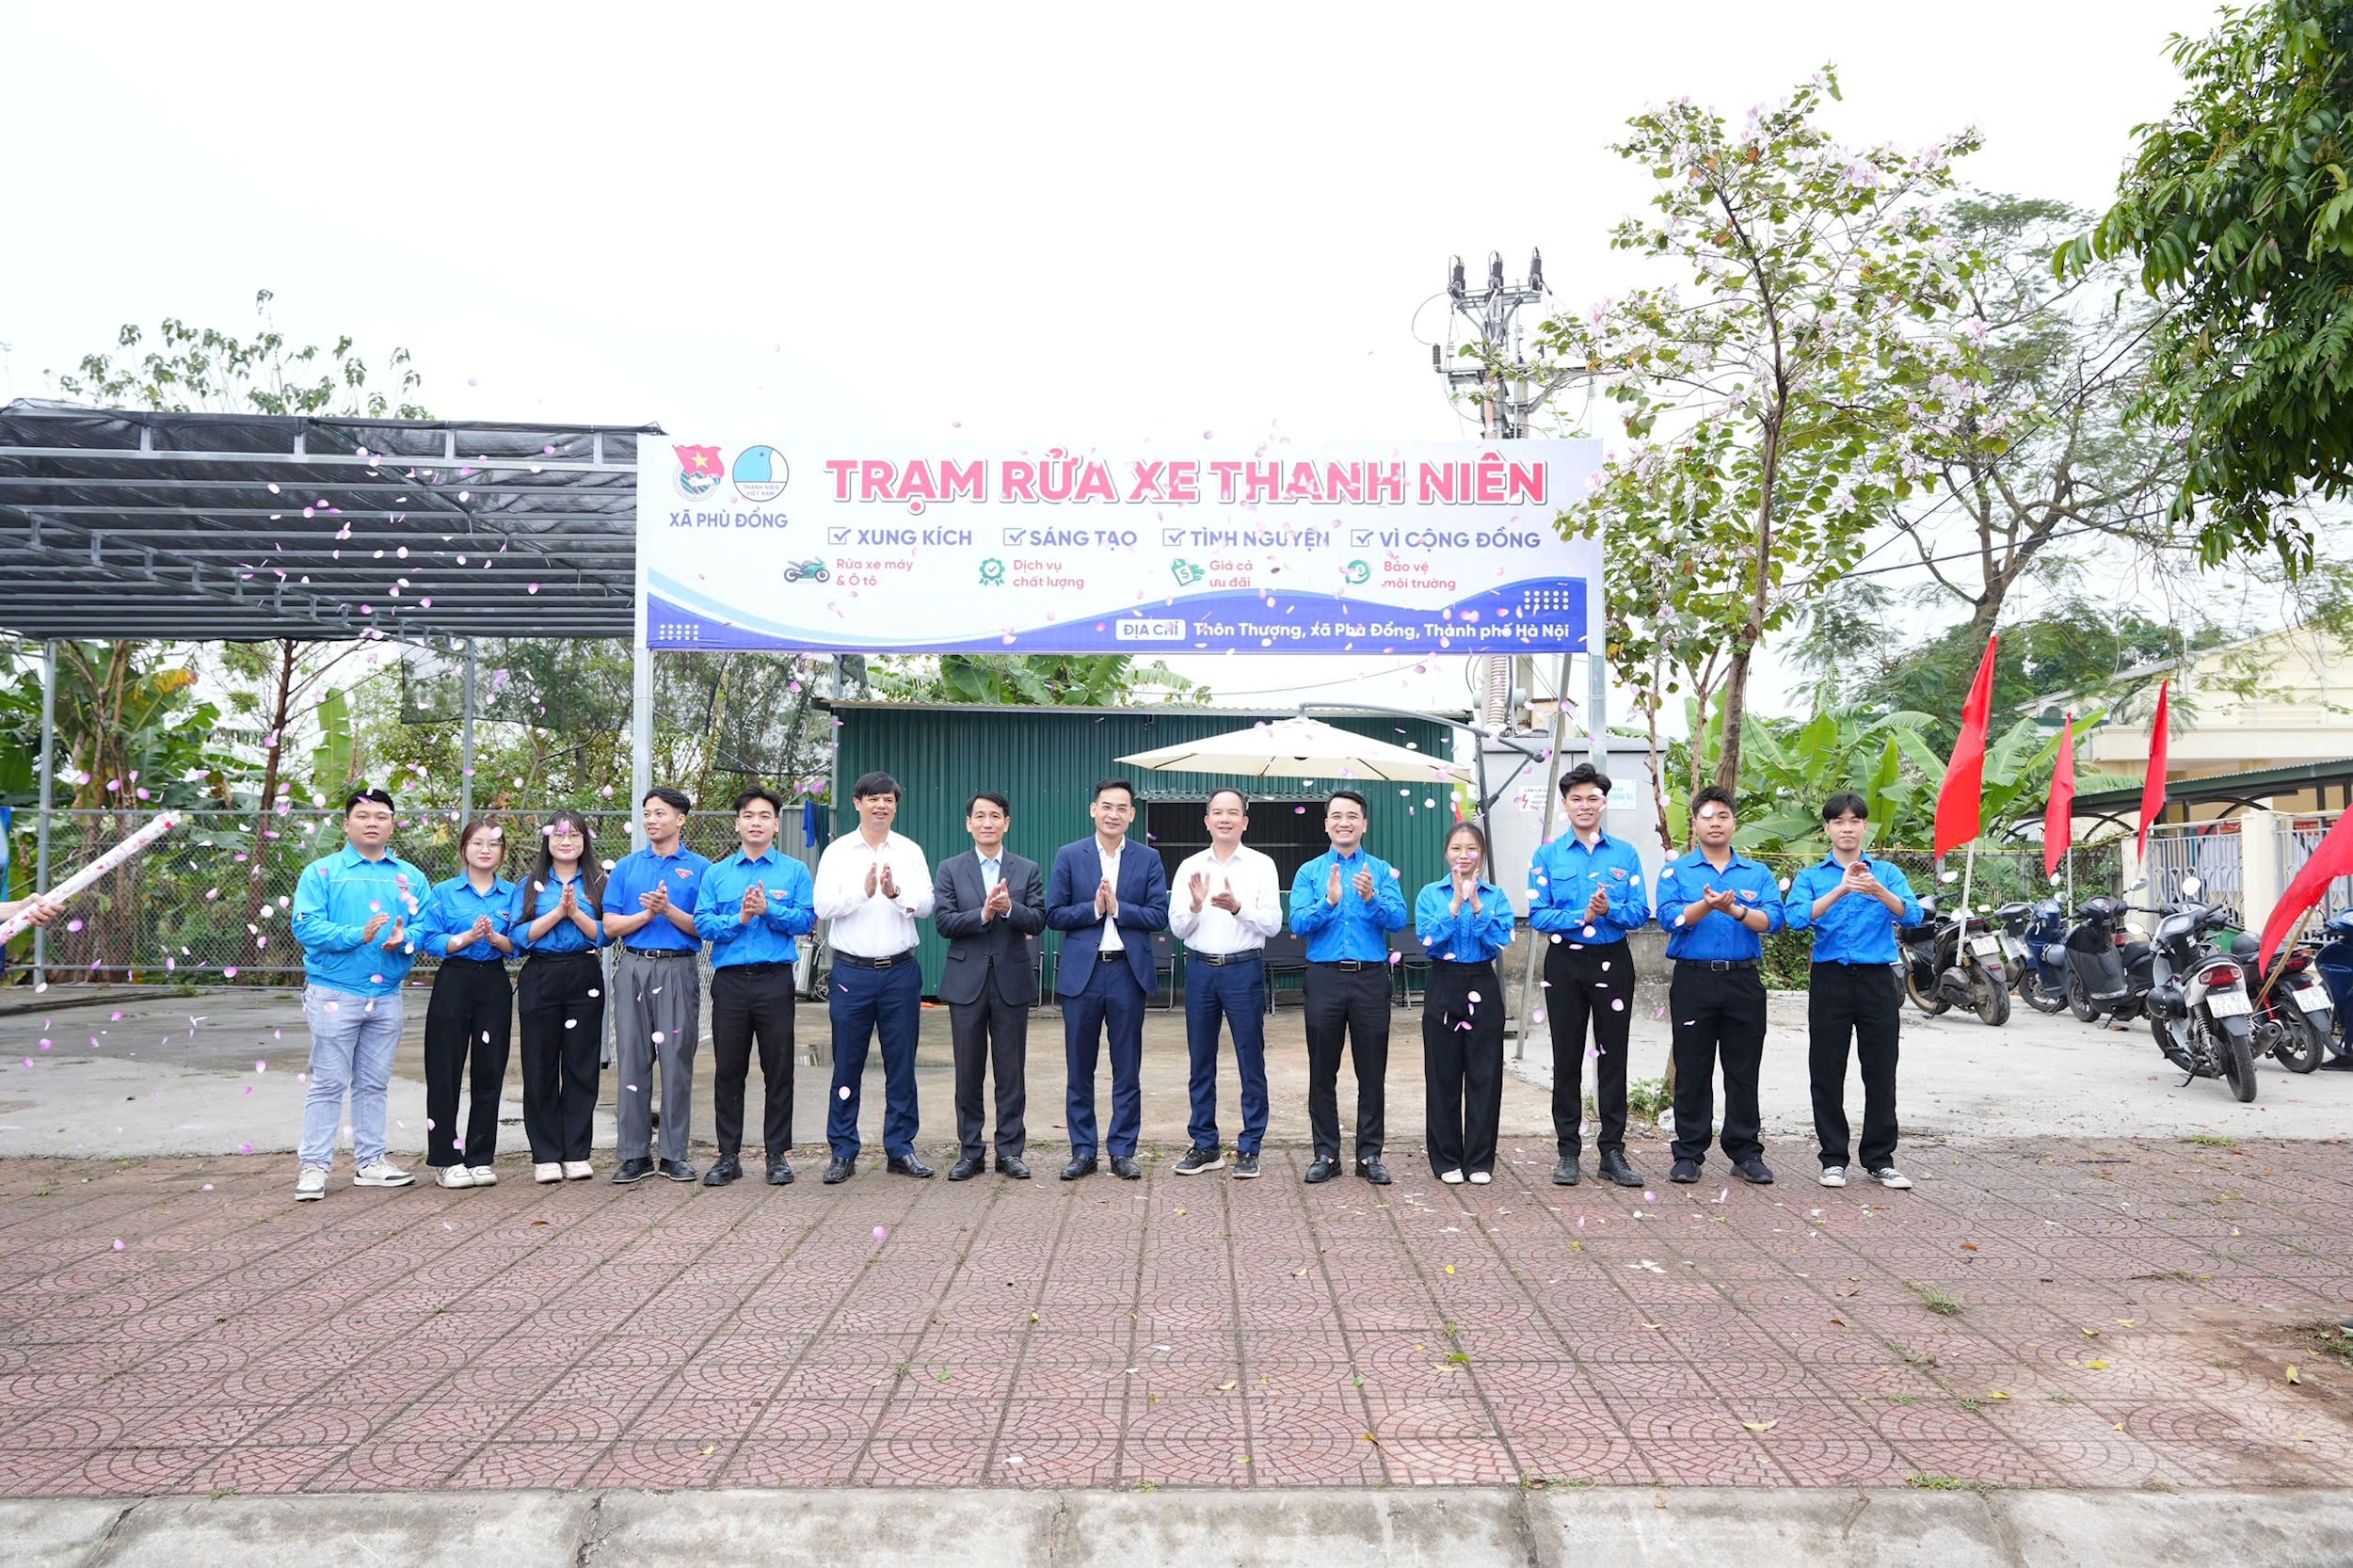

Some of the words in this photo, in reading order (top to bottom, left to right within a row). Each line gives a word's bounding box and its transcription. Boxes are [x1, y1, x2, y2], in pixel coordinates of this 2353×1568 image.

[824, 459, 984, 513] TRẠM
[1000, 447, 1117, 502] RỬA
[1128, 460, 1197, 502] XE
[1209, 461, 1403, 503] THANH
[1418, 452, 1545, 503] NIÊN
[669, 509, 693, 527] XÃ
[696, 509, 730, 527] PHÙ
[734, 506, 789, 528] ĐỔNG
[857, 529, 917, 545] XUNG
[922, 525, 972, 546] KÍCH
[1030, 526, 1090, 546] SÁNG
[1094, 530, 1138, 552] TẠO
[1191, 527, 1238, 547] TÌNH
[1243, 527, 1330, 552] NGUYỆN
[1379, 528, 1400, 548] VÌ
[1405, 528, 1470, 552] CỘNG
[1476, 526, 1541, 548] ĐỒNG
[837, 558, 862, 569] Rửa
[866, 561, 881, 569] xe
[885, 559, 913, 571] máy
[1013, 559, 1043, 573] Dịch
[1047, 562, 1063, 573] vụ
[1209, 560, 1234, 570] Giá
[1237, 559, 1253, 570] cả
[1384, 560, 1410, 572] Bảo
[1413, 562, 1430, 574] vệ
[837, 575, 845, 585] &
[848, 573, 860, 585] Ô
[863, 575, 877, 585] tô
[1013, 575, 1044, 587] chất
[1047, 576, 1085, 590] lượng
[1209, 578, 1225, 587] ưu
[1229, 576, 1251, 587] đãi
[1384, 578, 1408, 588] môi
[1411, 578, 1457, 591] trường
[1123, 624, 1150, 639] ĐỊA
[1193, 622, 1235, 636] Thôn
[1238, 622, 1306, 640] Thượng,
[1310, 622, 1331, 636] xã
[1369, 621, 1421, 640] Đổng,
[1423, 622, 1477, 637] Thành
[1480, 622, 1513, 641] phố
[1515, 623, 1539, 637] Hà
[1543, 623, 1570, 641] Nội
